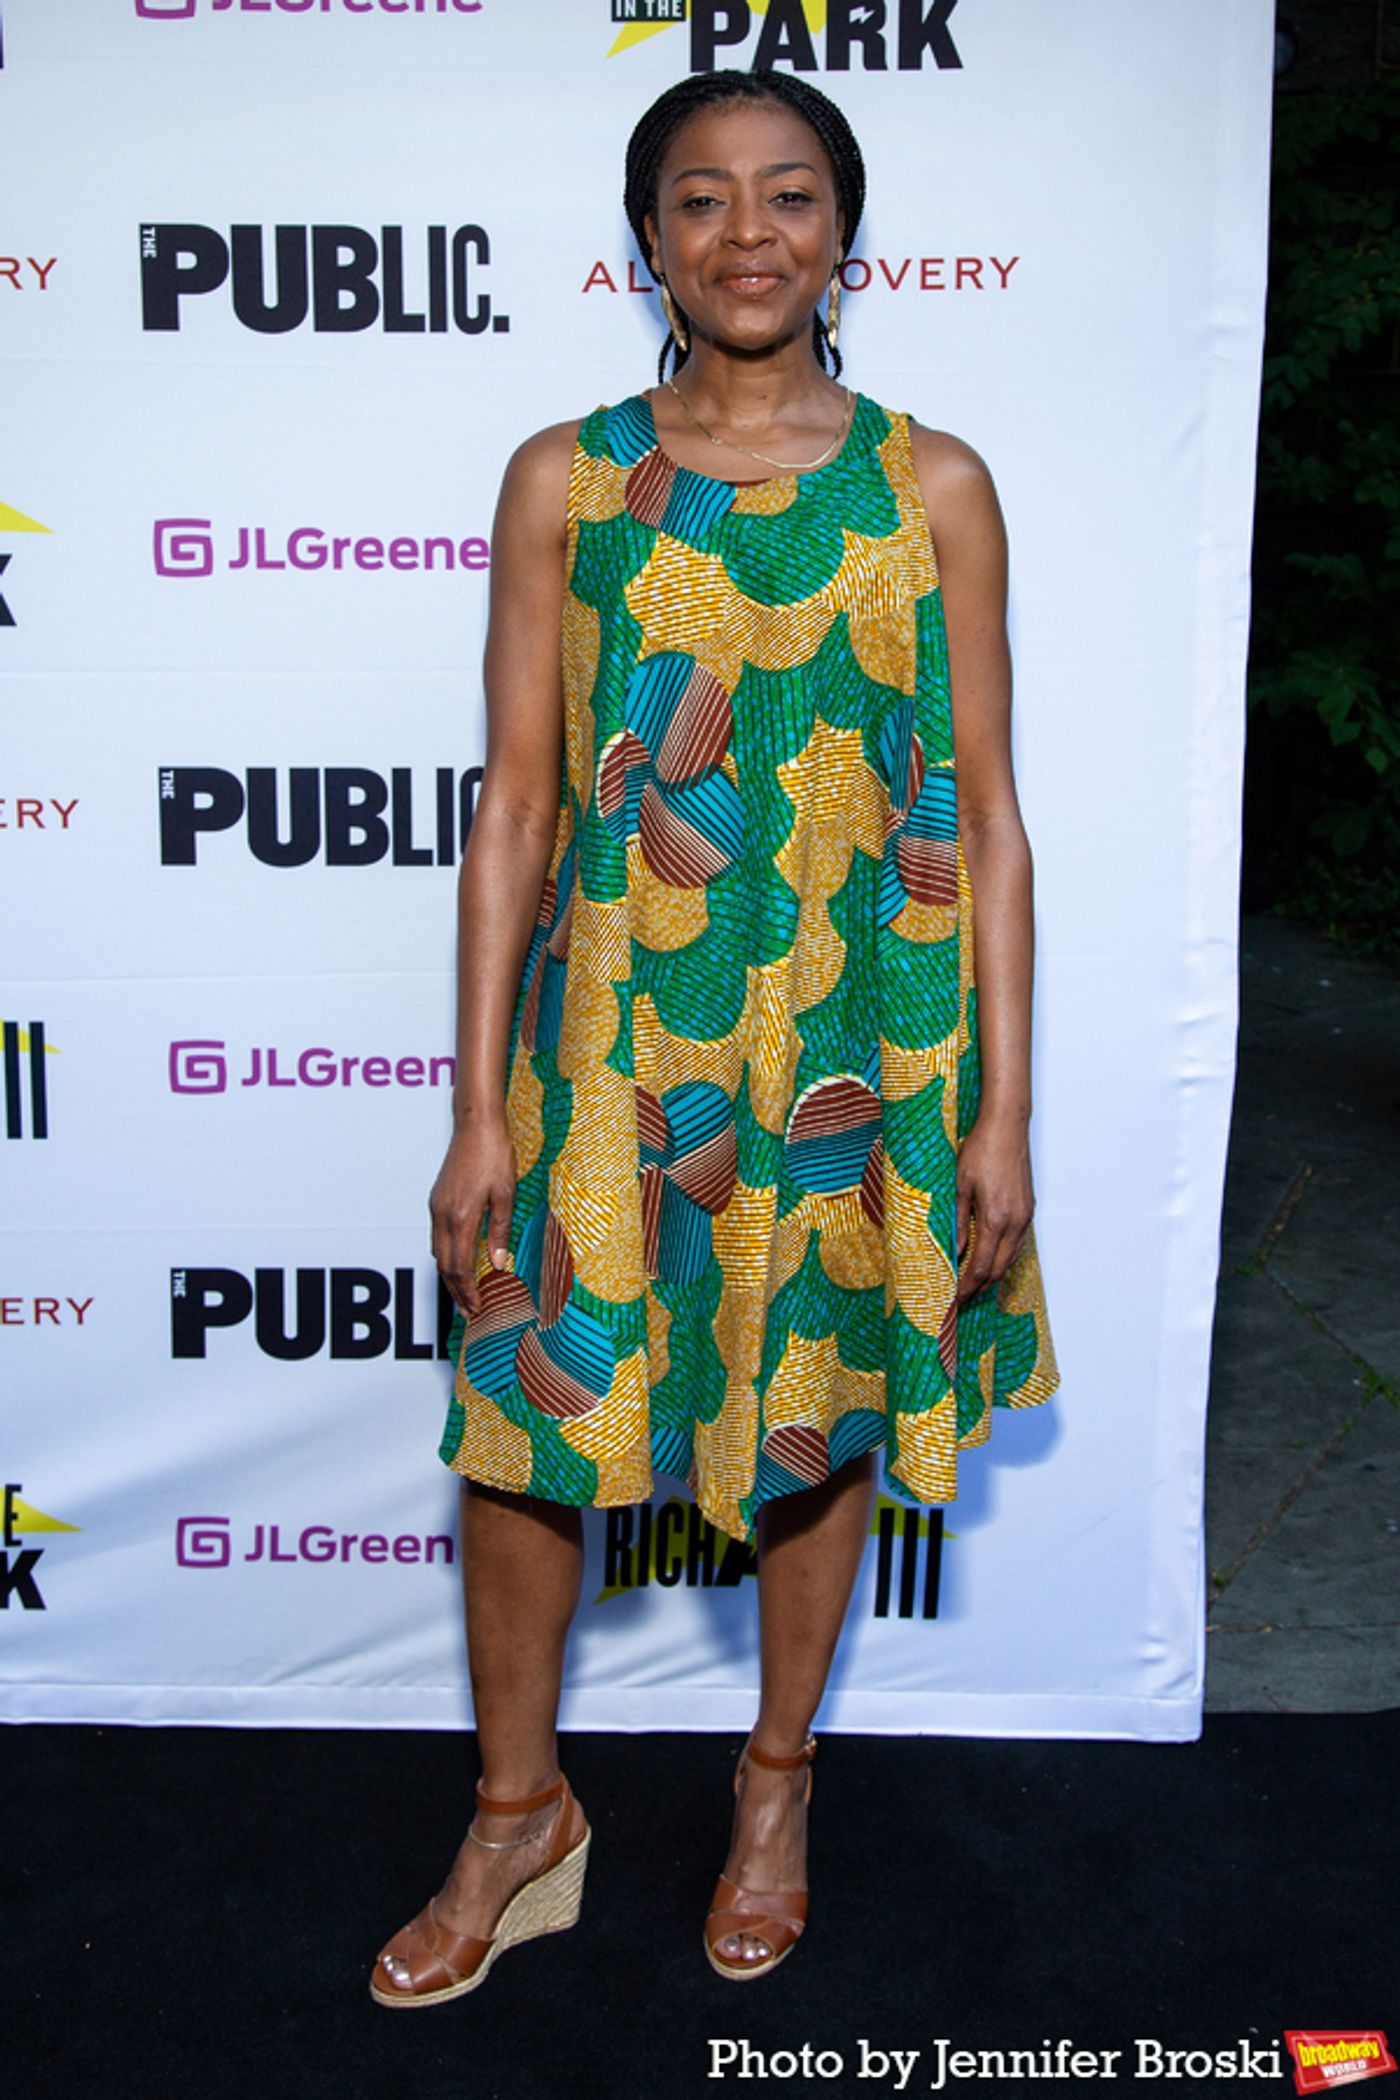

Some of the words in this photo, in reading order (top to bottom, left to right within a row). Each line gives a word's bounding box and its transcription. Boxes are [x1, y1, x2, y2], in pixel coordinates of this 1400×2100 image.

[616, 0, 636, 17] IN
[644, 0, 682, 17] THE
[690, 0, 963, 71] PARK
[142, 226, 157, 258] THE
[229, 527, 490, 570] JLGreene
[161, 770, 175, 799] THE
[241, 1047, 457, 1087] JLGreen
[0, 1297, 94, 1325] ERY
[245, 1524, 454, 1565] JLGreen
[875, 1507, 944, 1619] III
